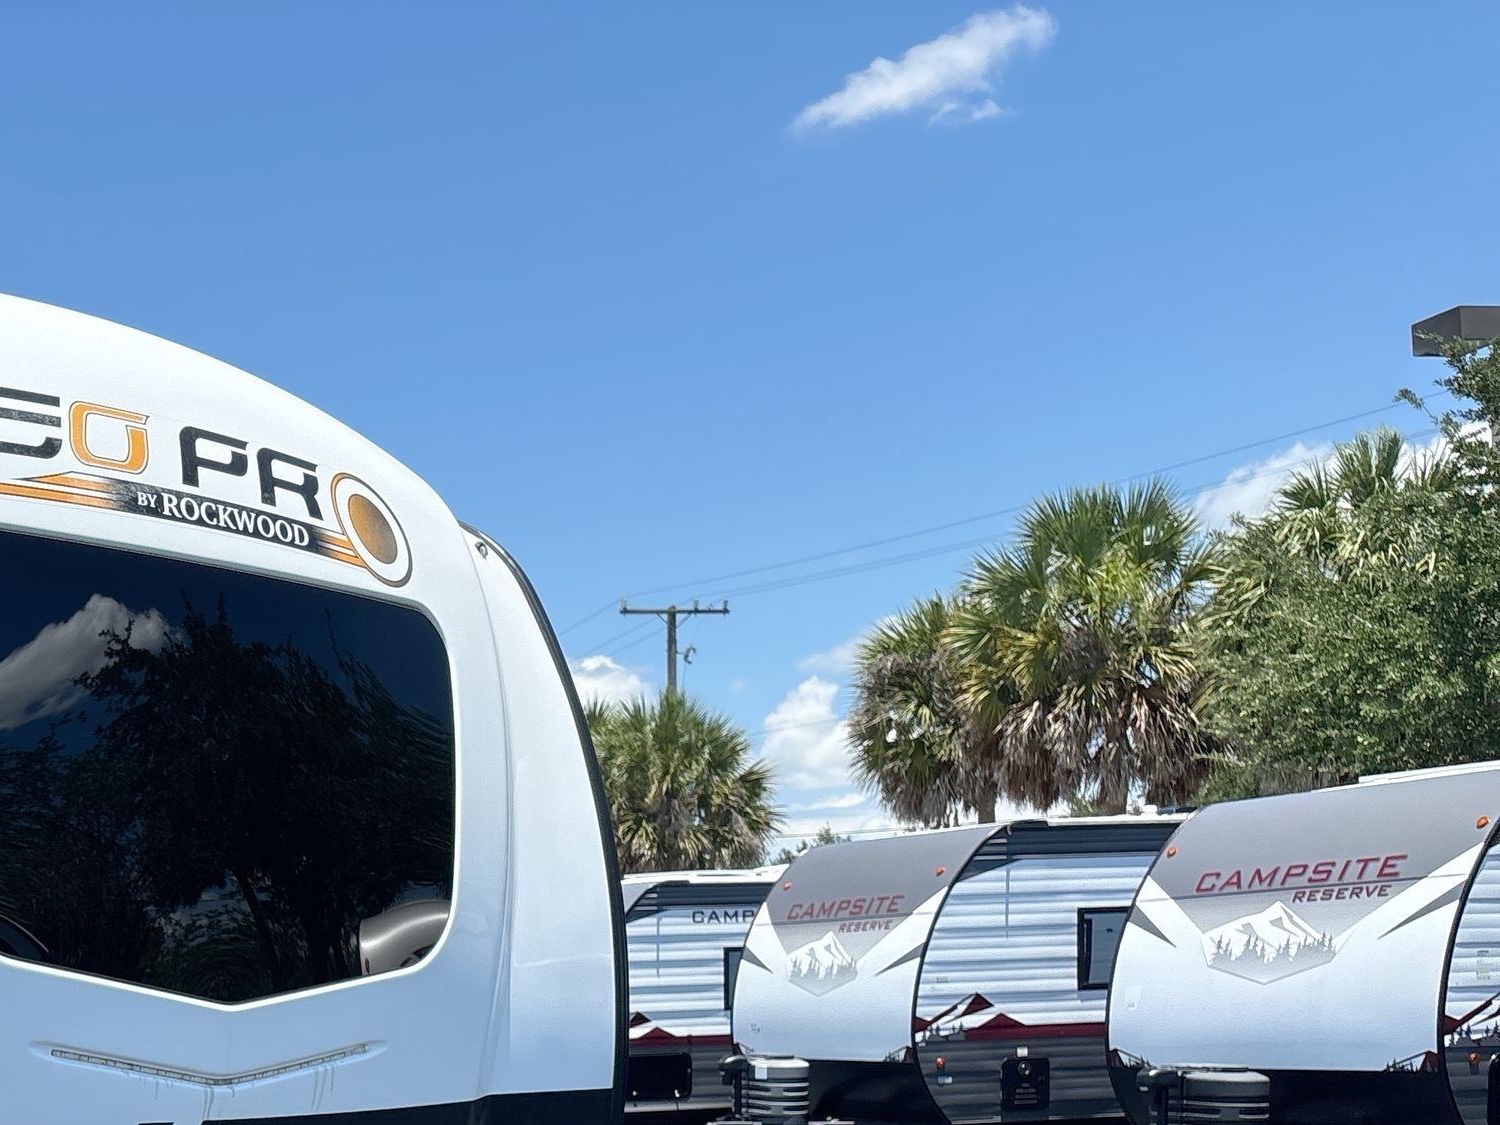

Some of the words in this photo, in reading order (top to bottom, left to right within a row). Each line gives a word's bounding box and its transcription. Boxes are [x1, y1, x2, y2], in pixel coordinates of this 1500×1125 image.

[137, 490, 159, 510] BY
[161, 492, 310, 548] ROCKWOOD
[179, 426, 412, 588] PRO
[1195, 854, 1408, 894] CAMPSITE
[787, 895, 905, 921] CAMPSITE
[1291, 884, 1392, 904] RESERVE
[838, 919, 893, 934] RESERVE
